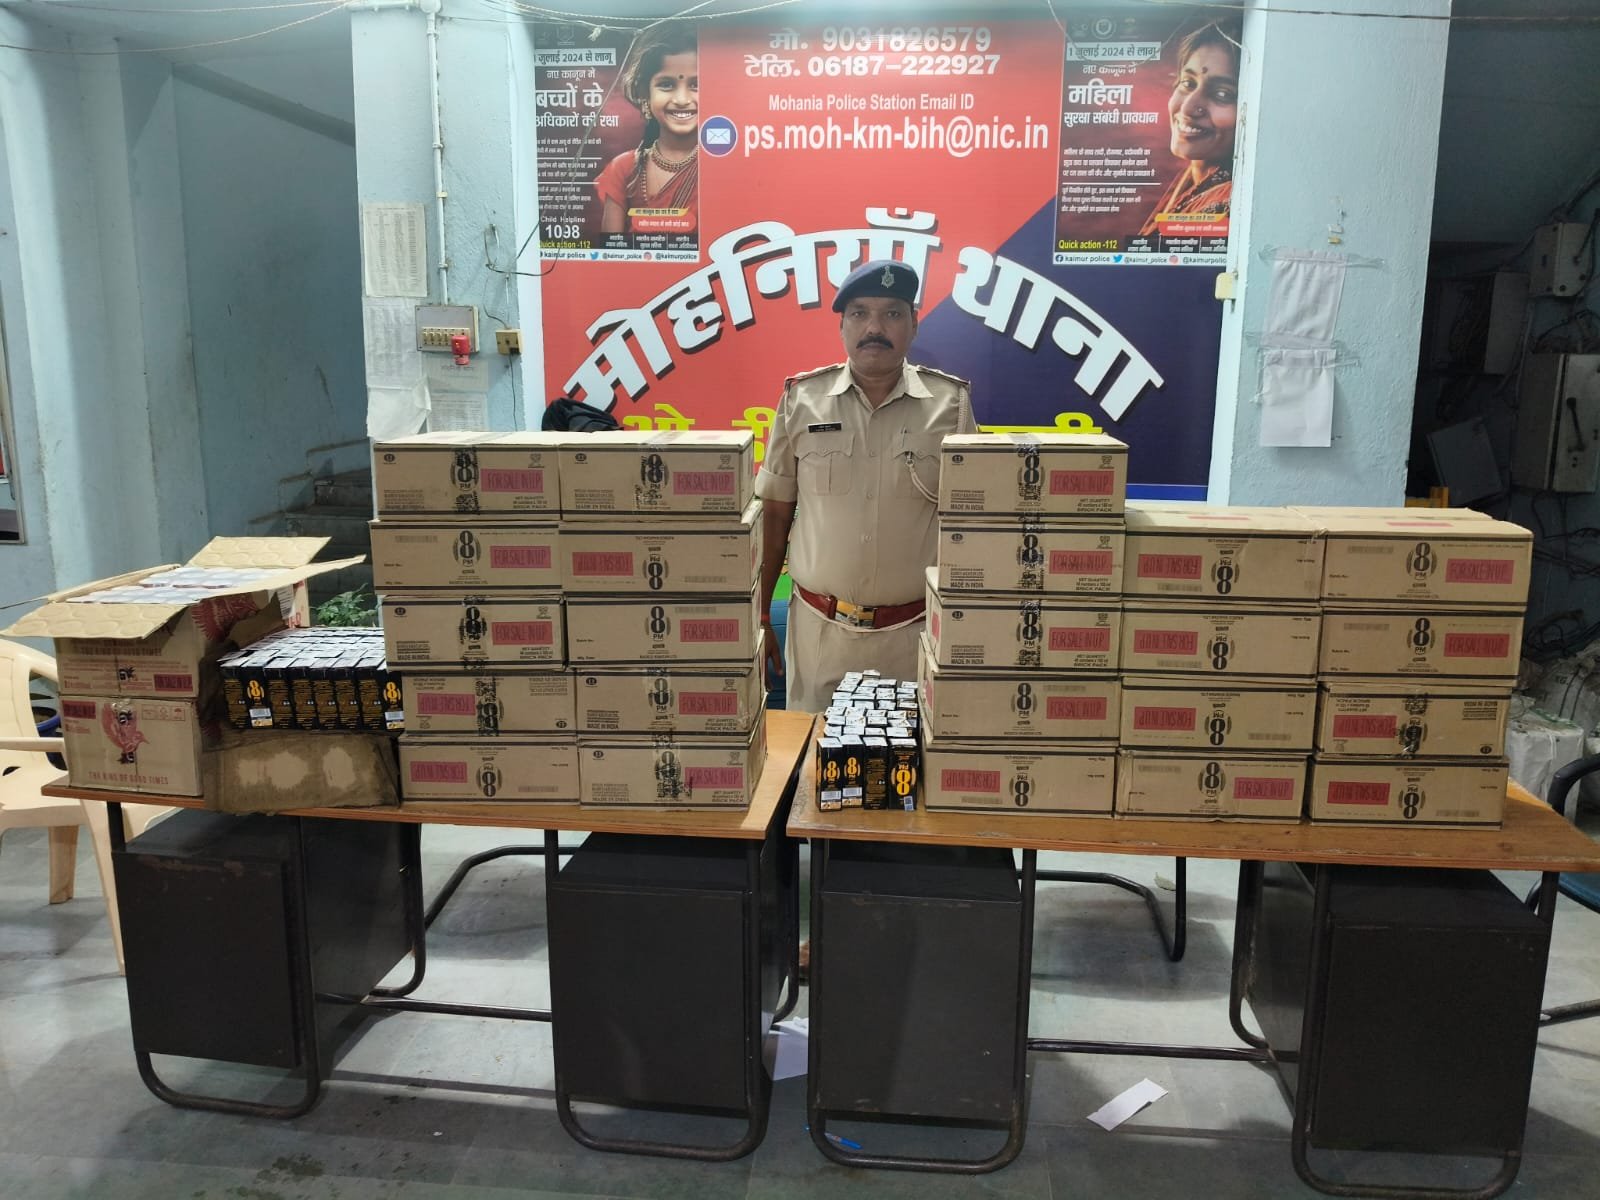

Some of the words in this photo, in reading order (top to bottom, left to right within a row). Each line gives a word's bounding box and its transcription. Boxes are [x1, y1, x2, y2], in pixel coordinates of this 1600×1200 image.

[823, 27, 991, 51] 9031826579
[562, 54, 583, 62] 2024
[1102, 48, 1124, 56] 2024
[536, 83, 578, 108] बच्चों
[583, 82, 604, 107] के
[1068, 78, 1133, 105] महिला
[769, 94, 823, 111] Mohania
[827, 94, 866, 111] Police
[870, 94, 916, 110] Station
[920, 93, 956, 110] Email
[961, 93, 974, 109] ID
[1064, 112, 1090, 127] सुरक्षा
[744, 115, 1049, 158] ps.moh-km-bih@nic.in
[545, 224, 580, 239] 1098
[1059, 240, 1078, 249] Quick
[1080, 240, 1101, 249] action
[953, 247, 1164, 422] थाना
